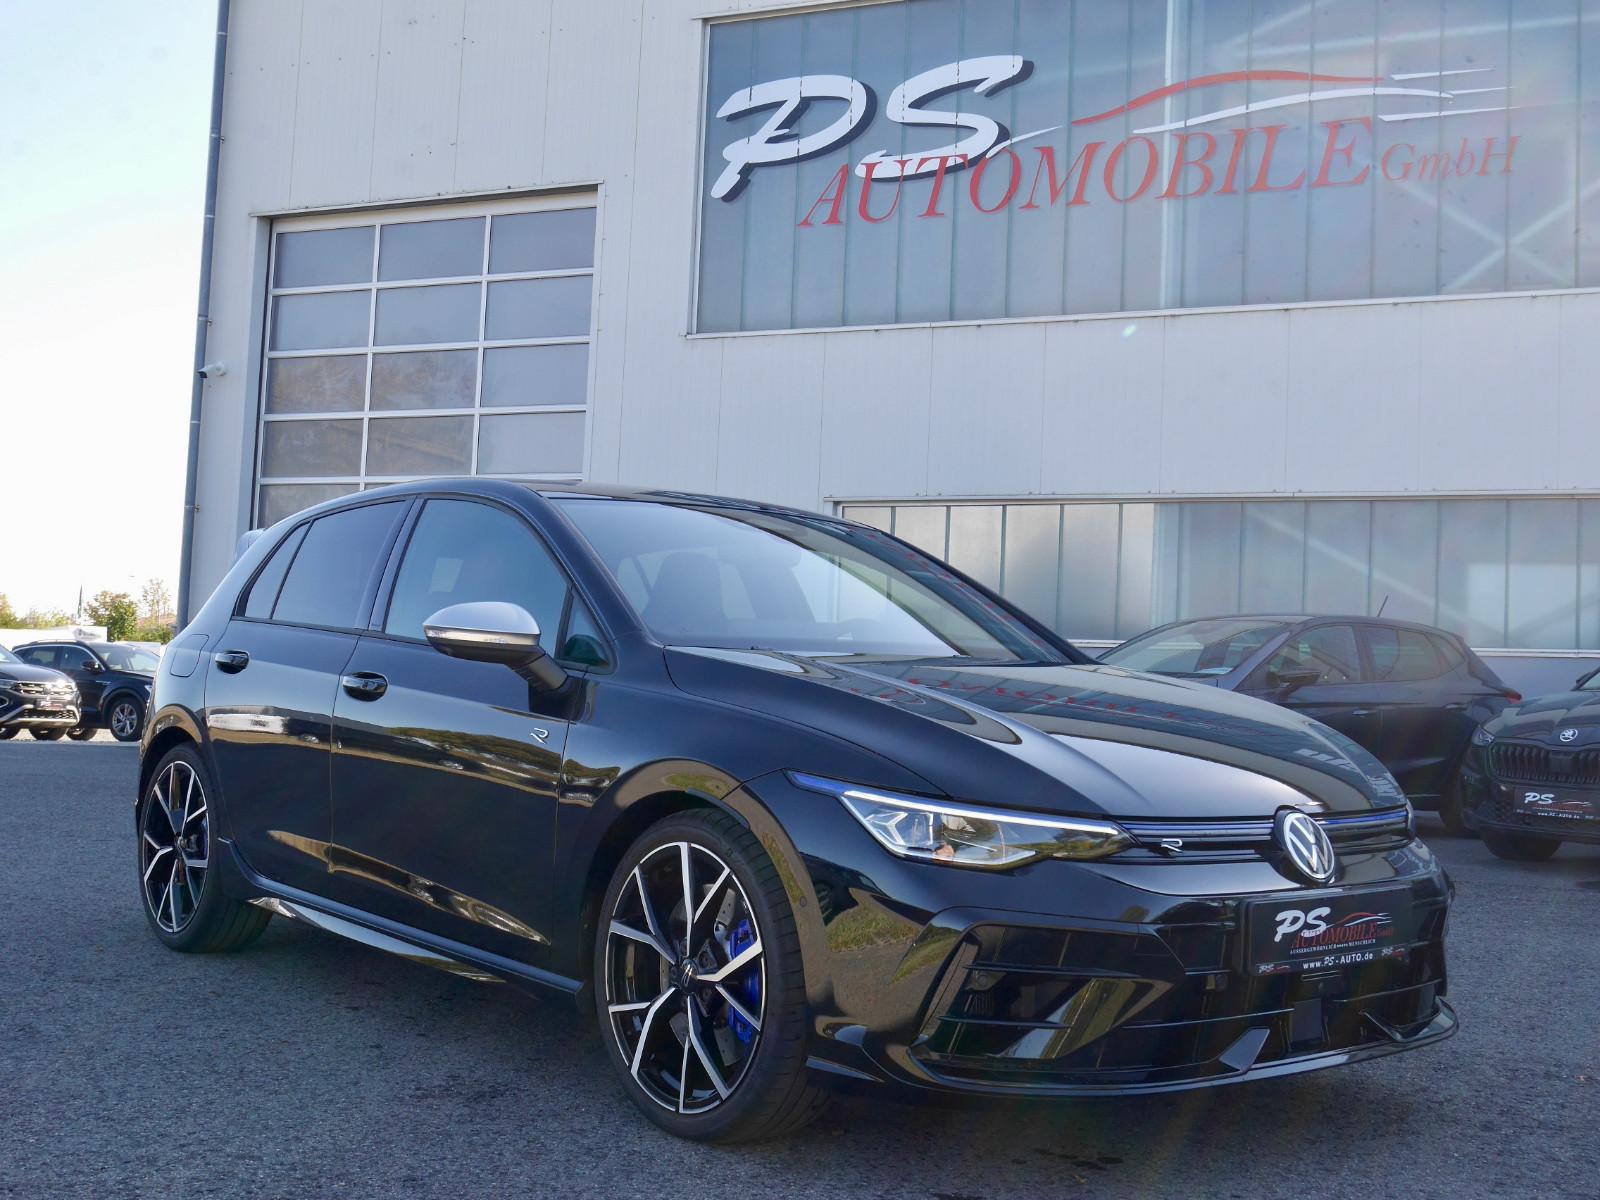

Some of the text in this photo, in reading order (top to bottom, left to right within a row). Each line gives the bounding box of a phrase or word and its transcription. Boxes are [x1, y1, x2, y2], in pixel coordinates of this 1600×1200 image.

[709, 54, 1034, 202] PS
[798, 116, 1521, 228] AUTOMOBILE GmbH
[1524, 792, 1554, 804] PS
[1274, 906, 1331, 942] PS
[1291, 922, 1377, 948] AUTOMOBILE
